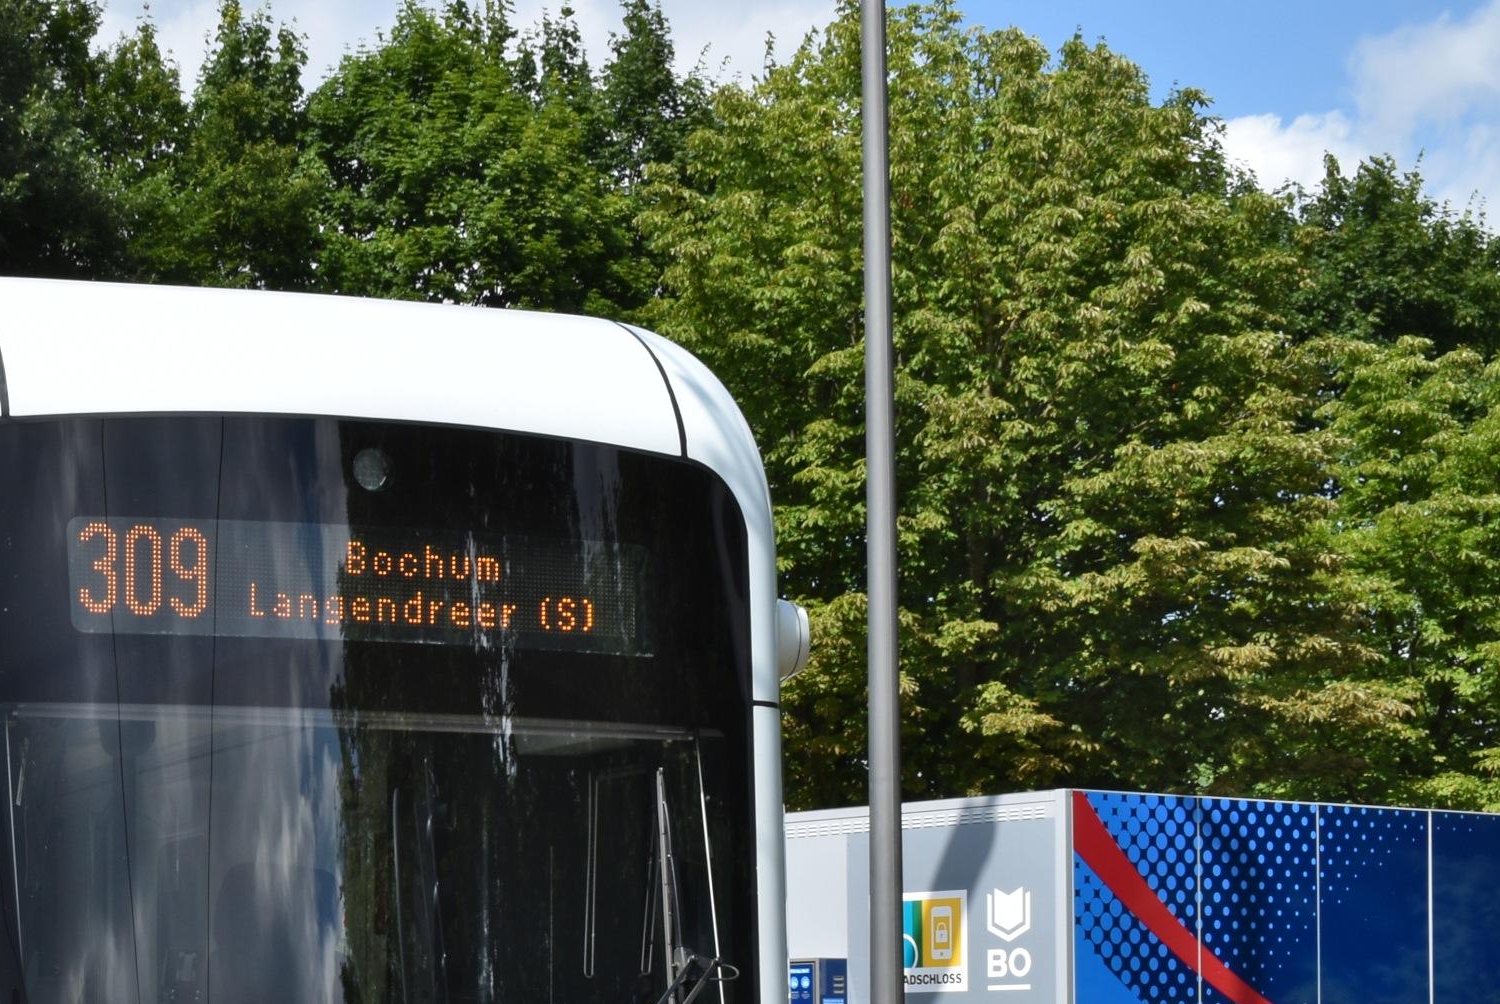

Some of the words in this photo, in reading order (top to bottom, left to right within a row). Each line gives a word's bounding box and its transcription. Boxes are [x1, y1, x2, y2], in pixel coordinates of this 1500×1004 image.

[77, 521, 209, 619] 309
[347, 541, 500, 581] Bochum
[250, 581, 516, 628] Langendreer
[540, 597, 594, 632] (S)
[987, 947, 1031, 977] BO
